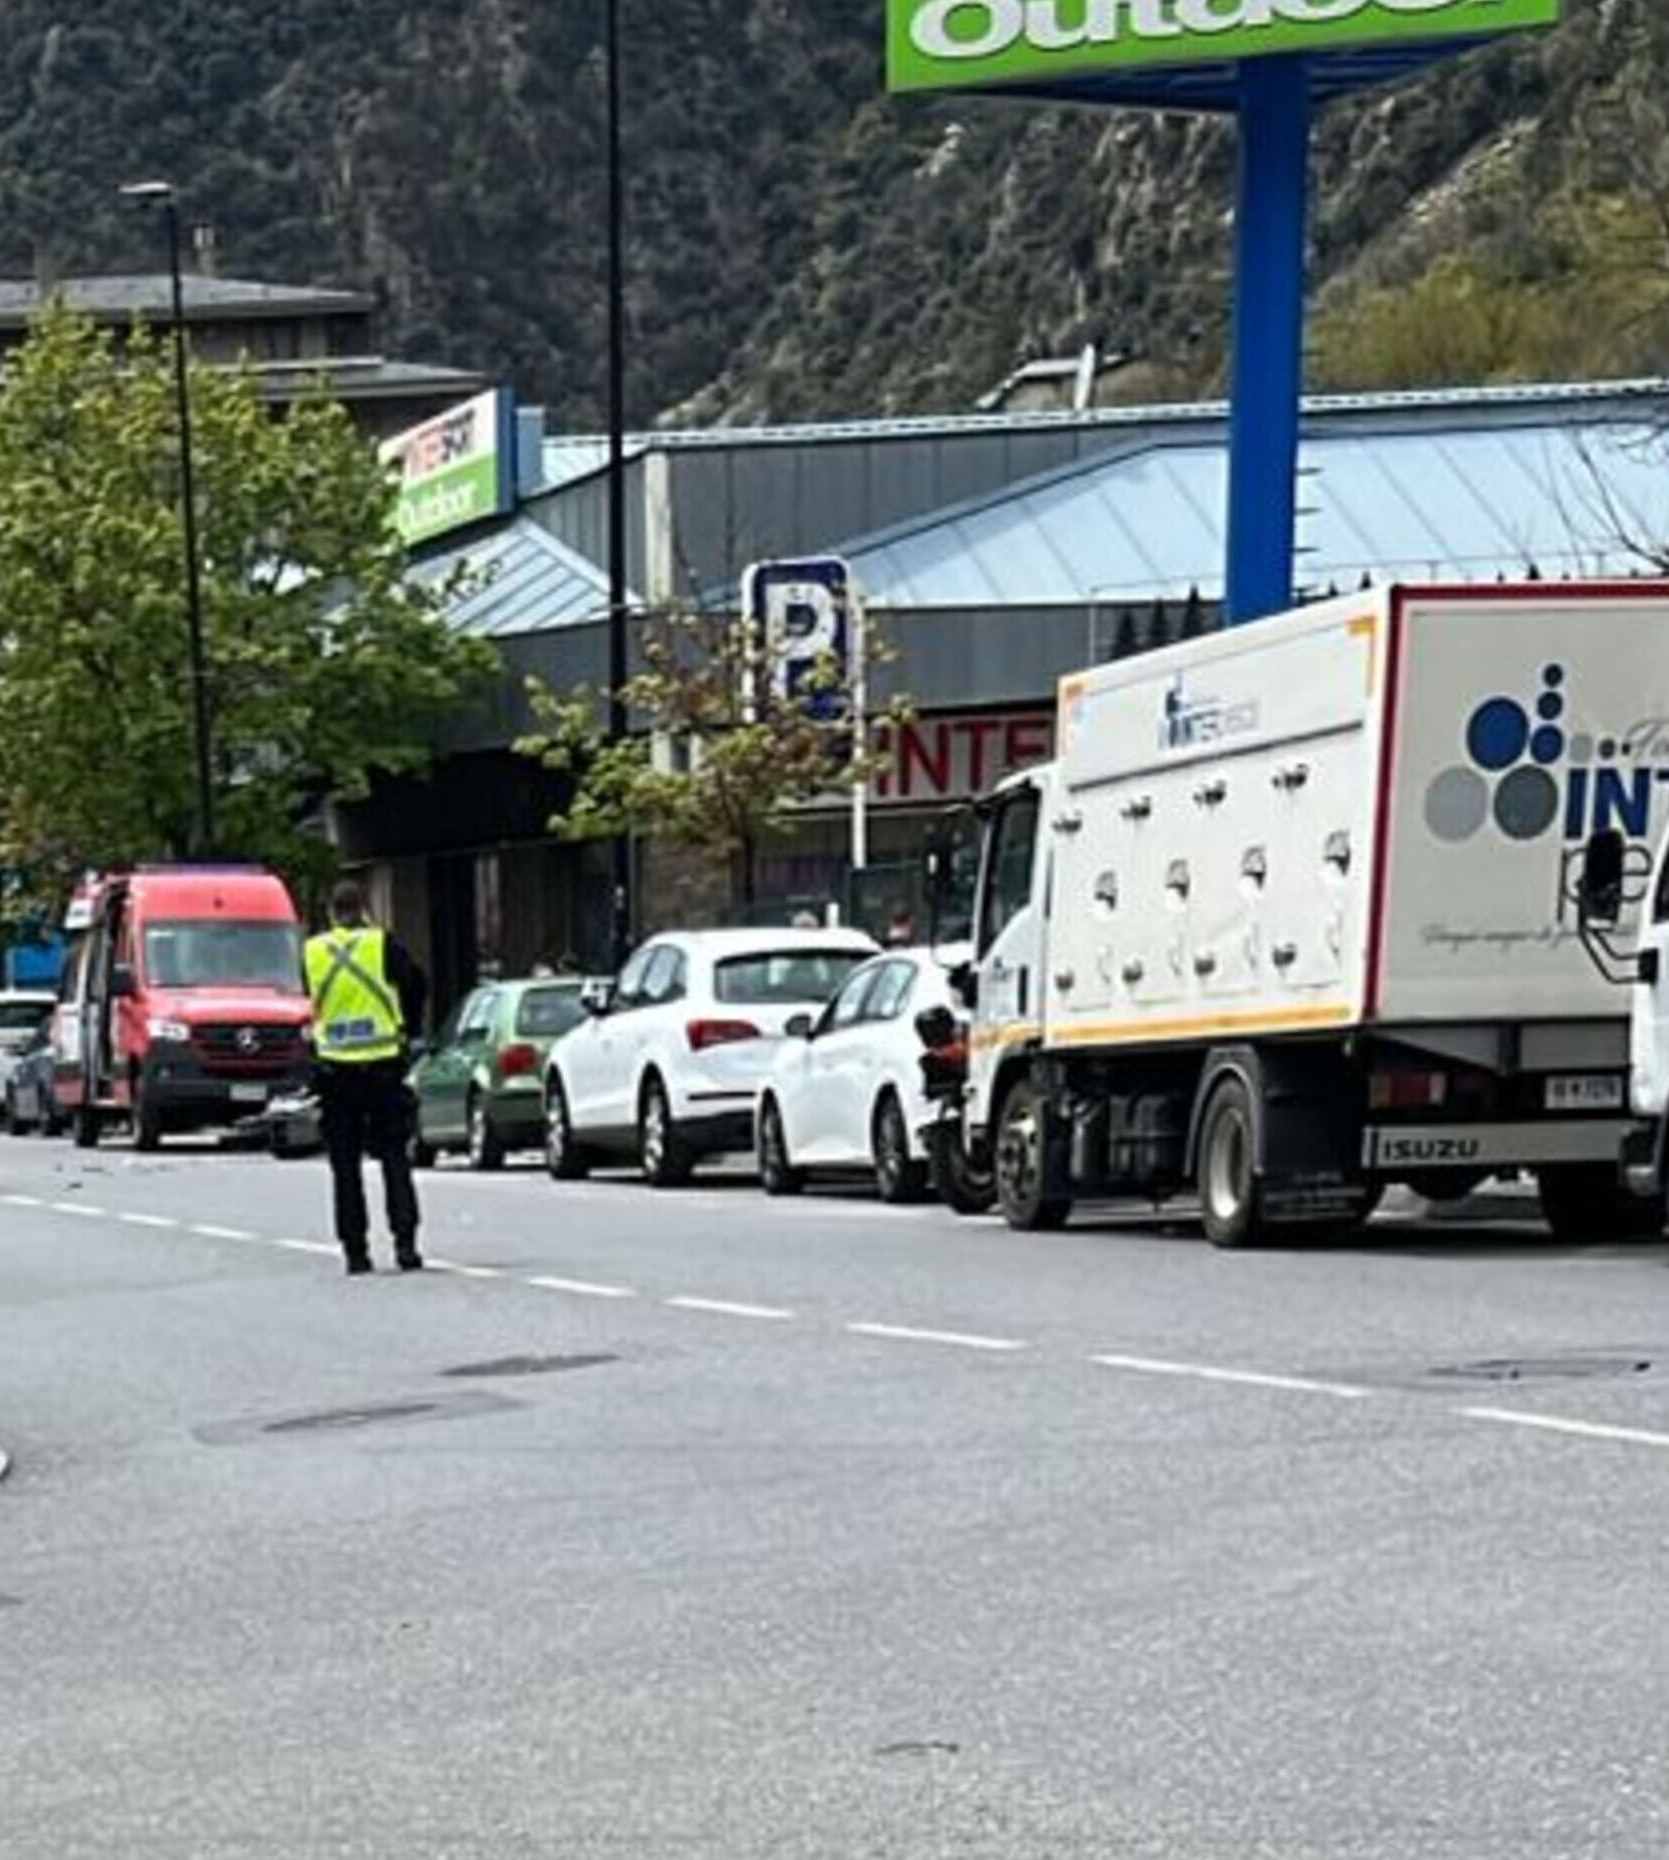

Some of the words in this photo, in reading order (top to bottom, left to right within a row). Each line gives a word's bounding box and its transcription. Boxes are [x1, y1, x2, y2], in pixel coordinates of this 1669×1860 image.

[765, 582, 835, 702] P
[1564, 767, 1669, 838] IN
[1385, 1138, 1479, 1160] ISUZU
